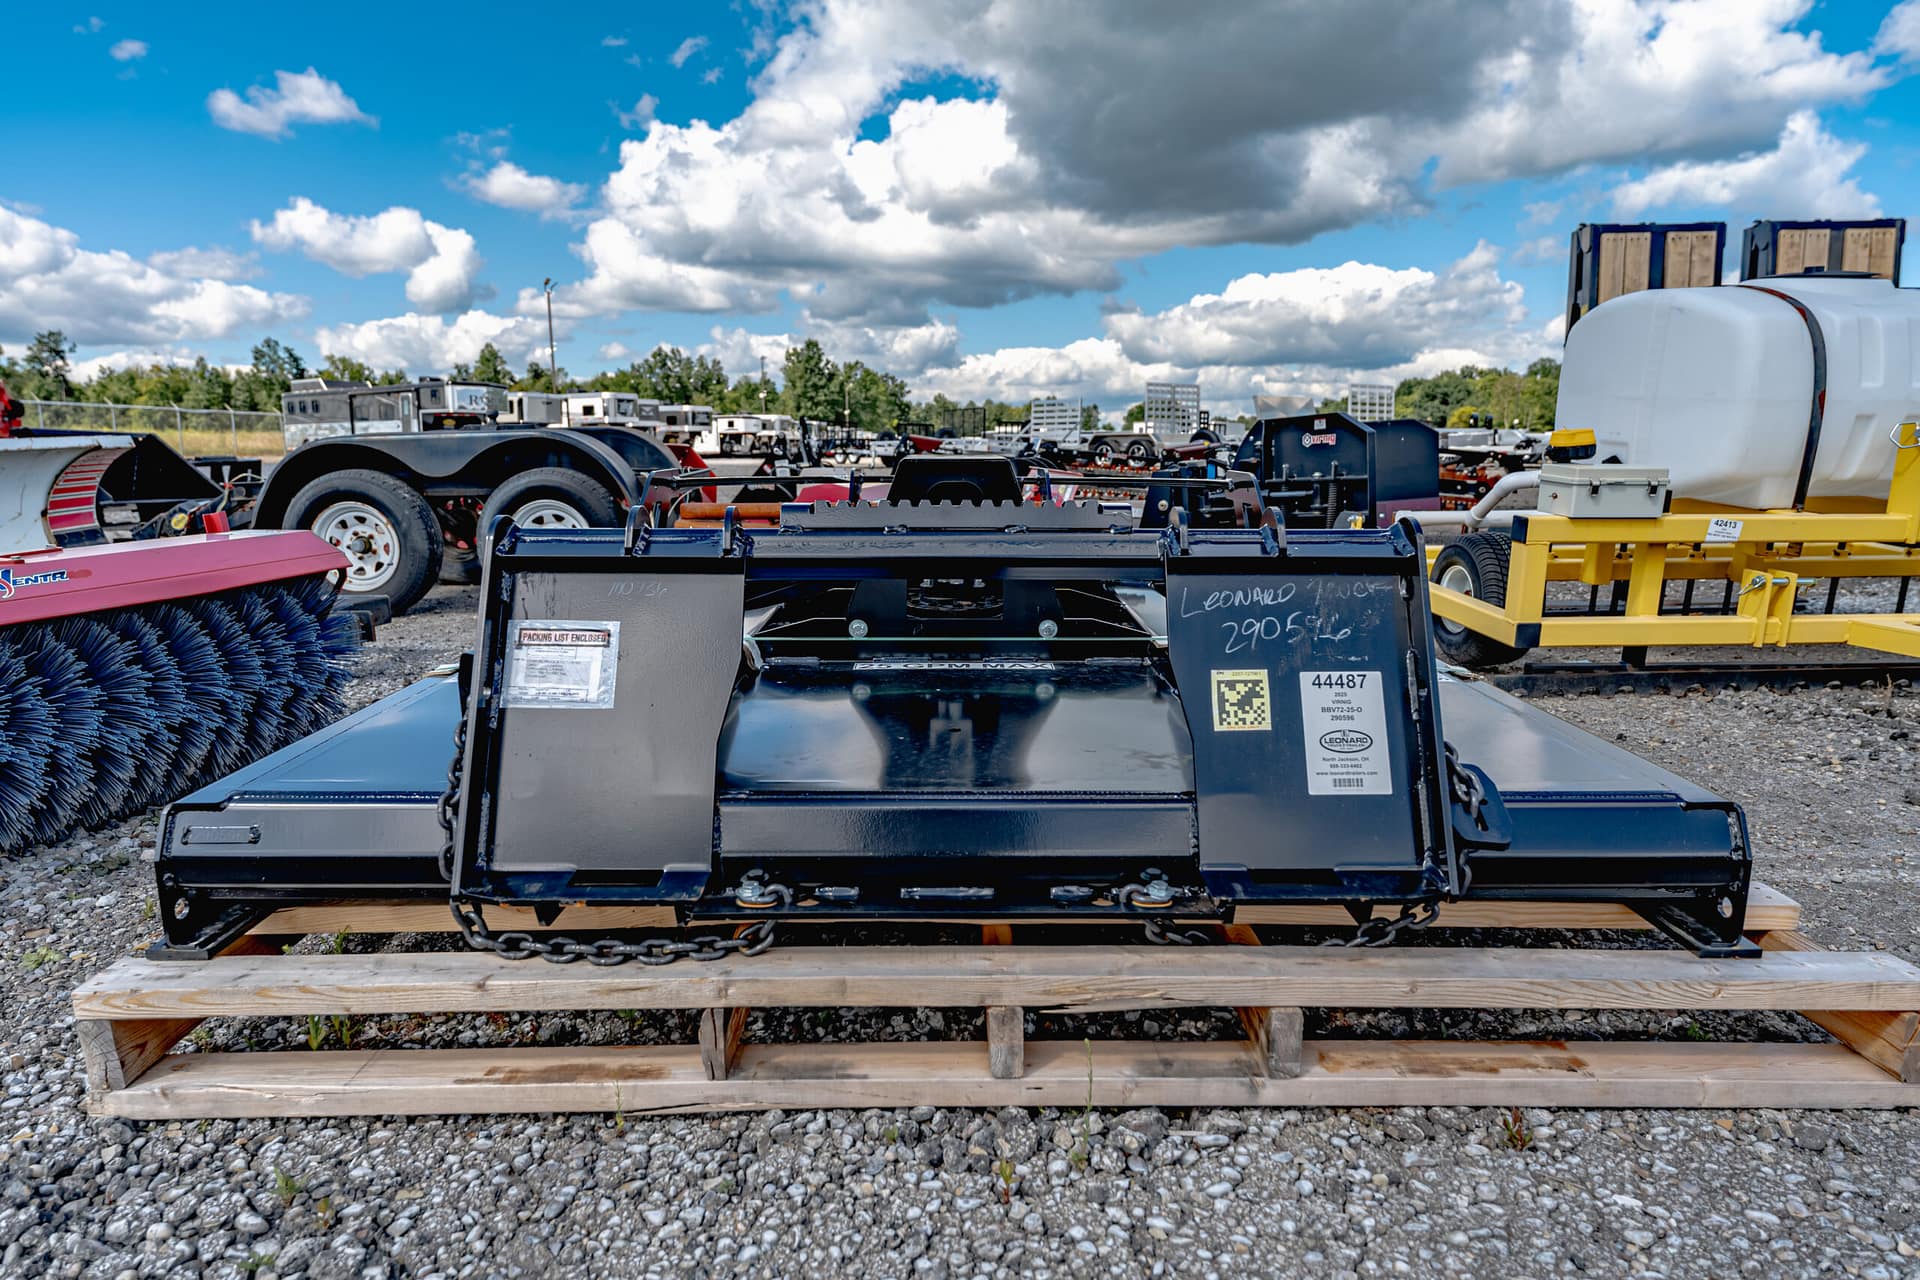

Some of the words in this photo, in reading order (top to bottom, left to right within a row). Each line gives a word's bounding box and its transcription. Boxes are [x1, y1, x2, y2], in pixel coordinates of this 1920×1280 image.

[1714, 519, 1737, 528] 42413
[522, 632, 553, 642] PACKING
[554, 632, 569, 642] LIST
[571, 633, 606, 643] ENCLOSED
[1311, 674, 1368, 689] 44487
